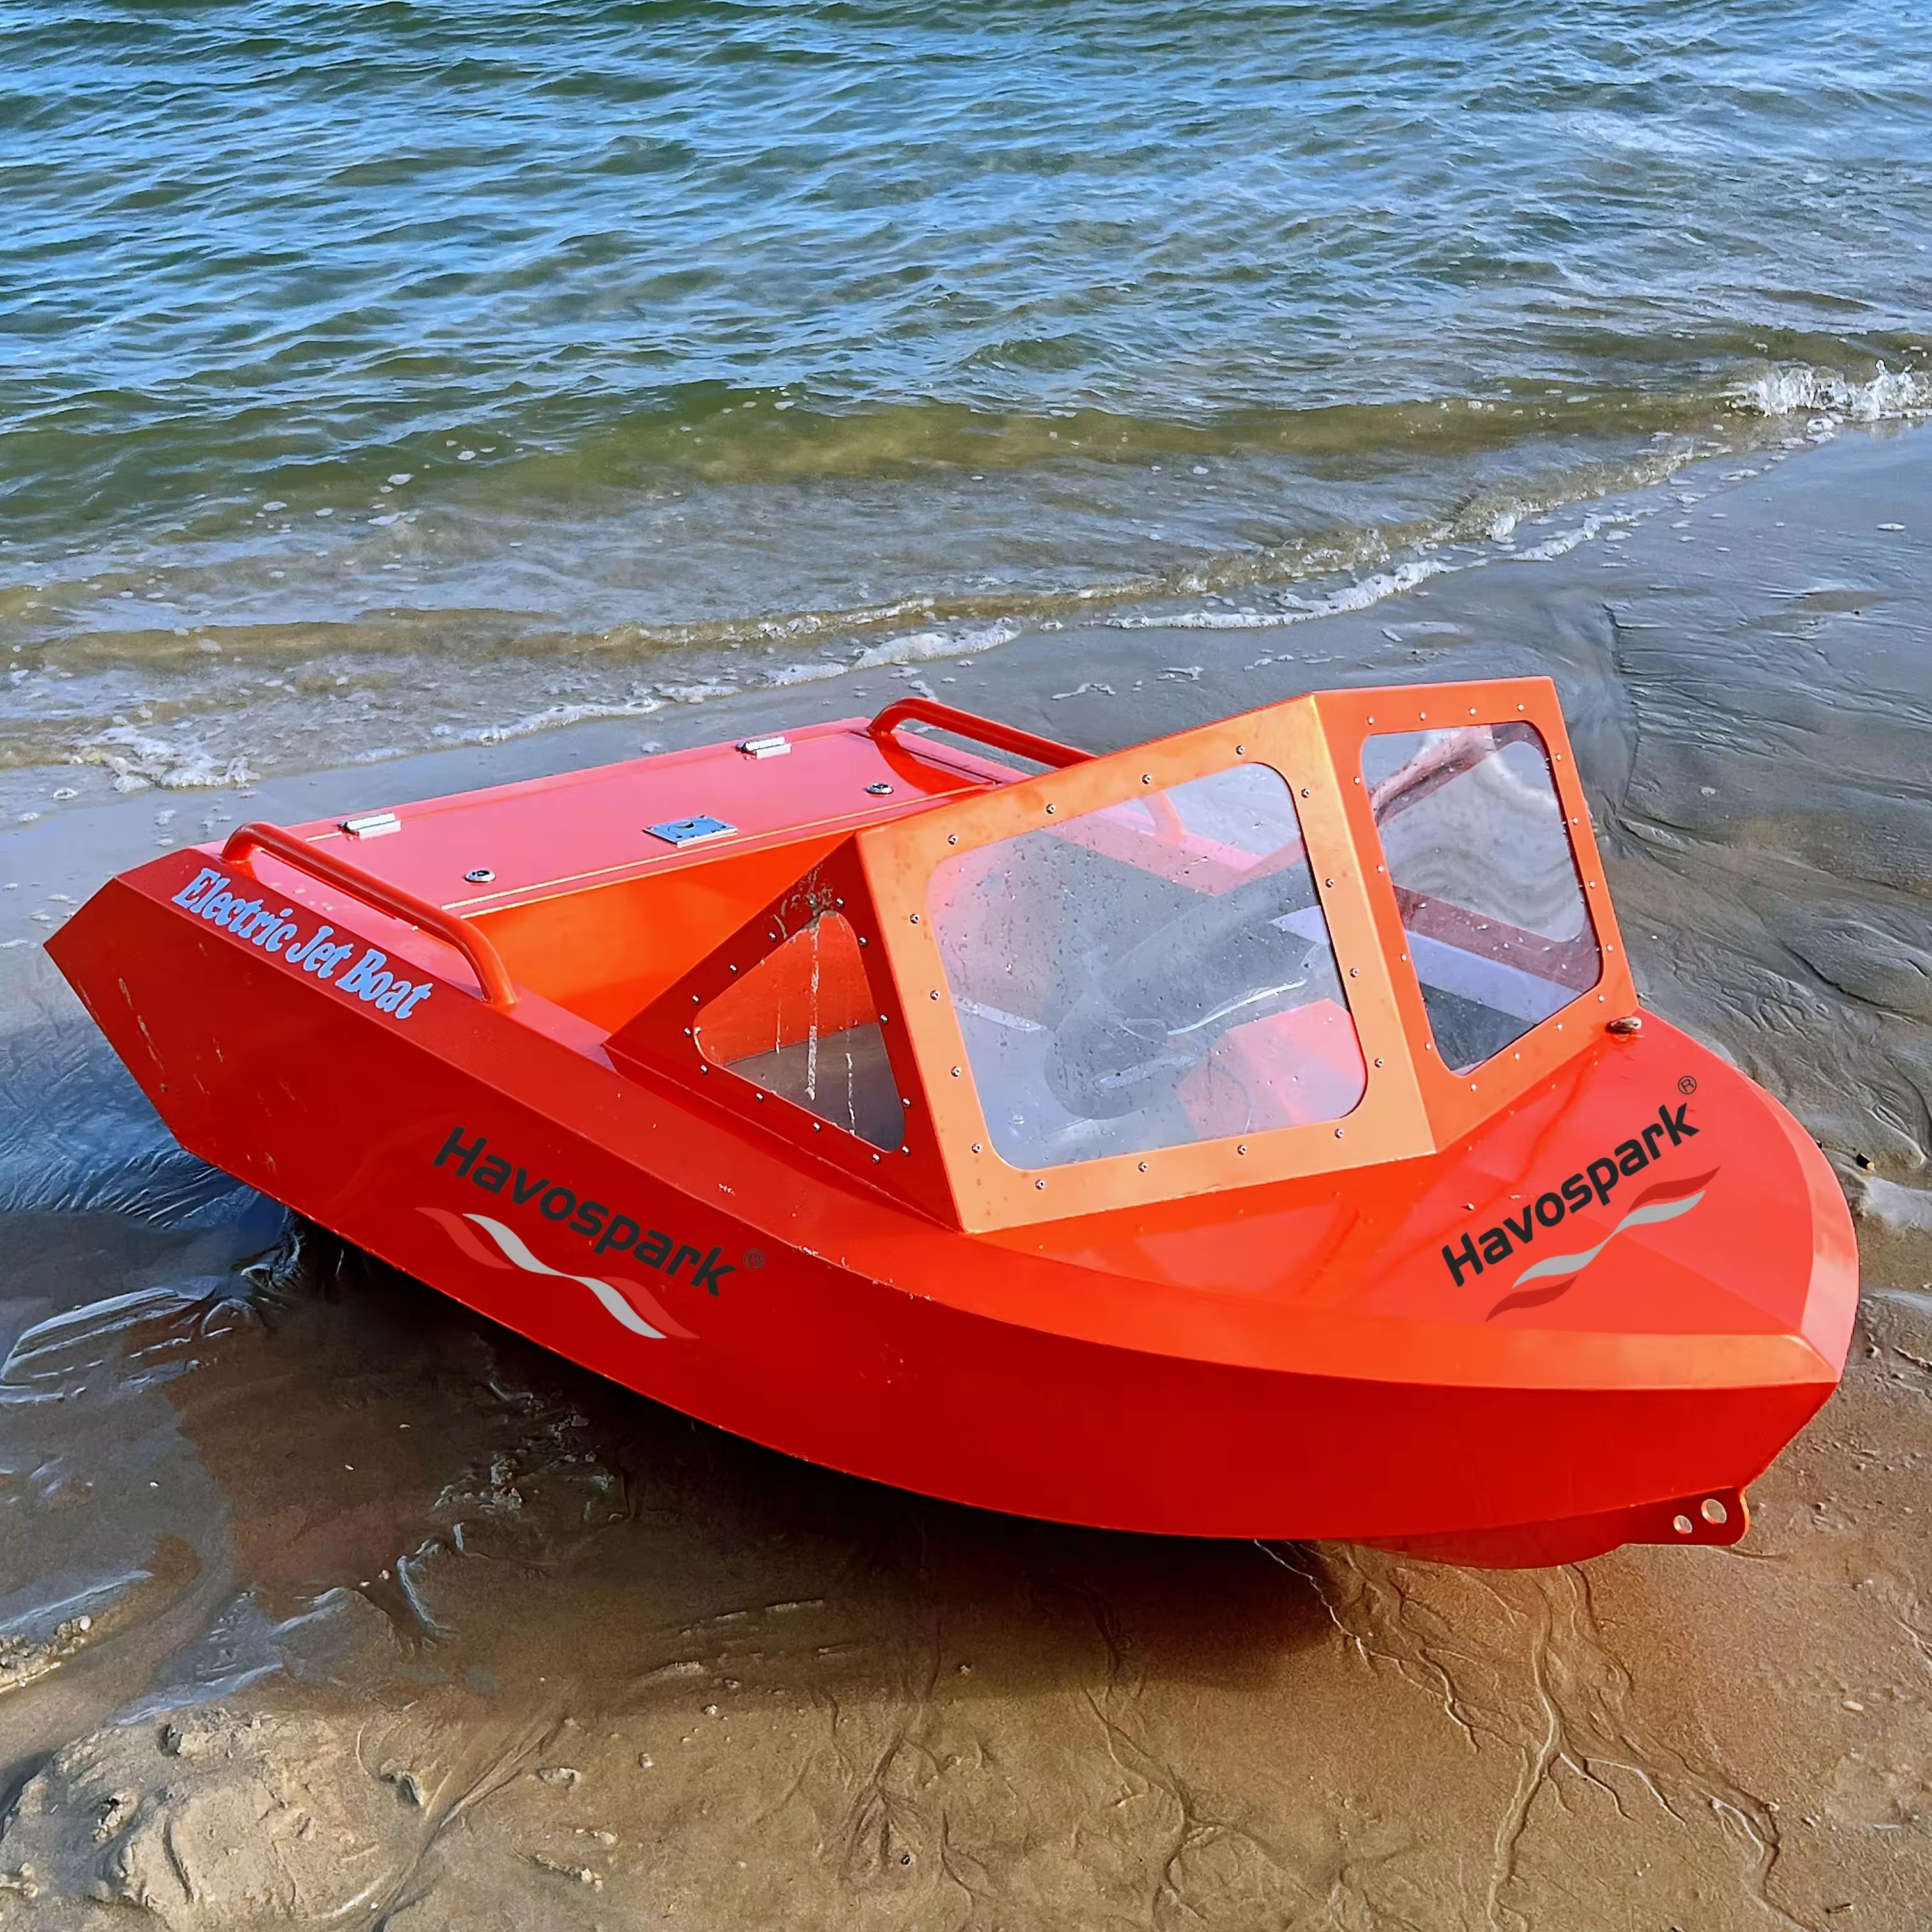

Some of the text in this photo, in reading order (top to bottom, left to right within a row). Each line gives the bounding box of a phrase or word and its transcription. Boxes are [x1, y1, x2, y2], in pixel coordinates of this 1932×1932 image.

[171, 868, 433, 1019] Electric Jet Boat
